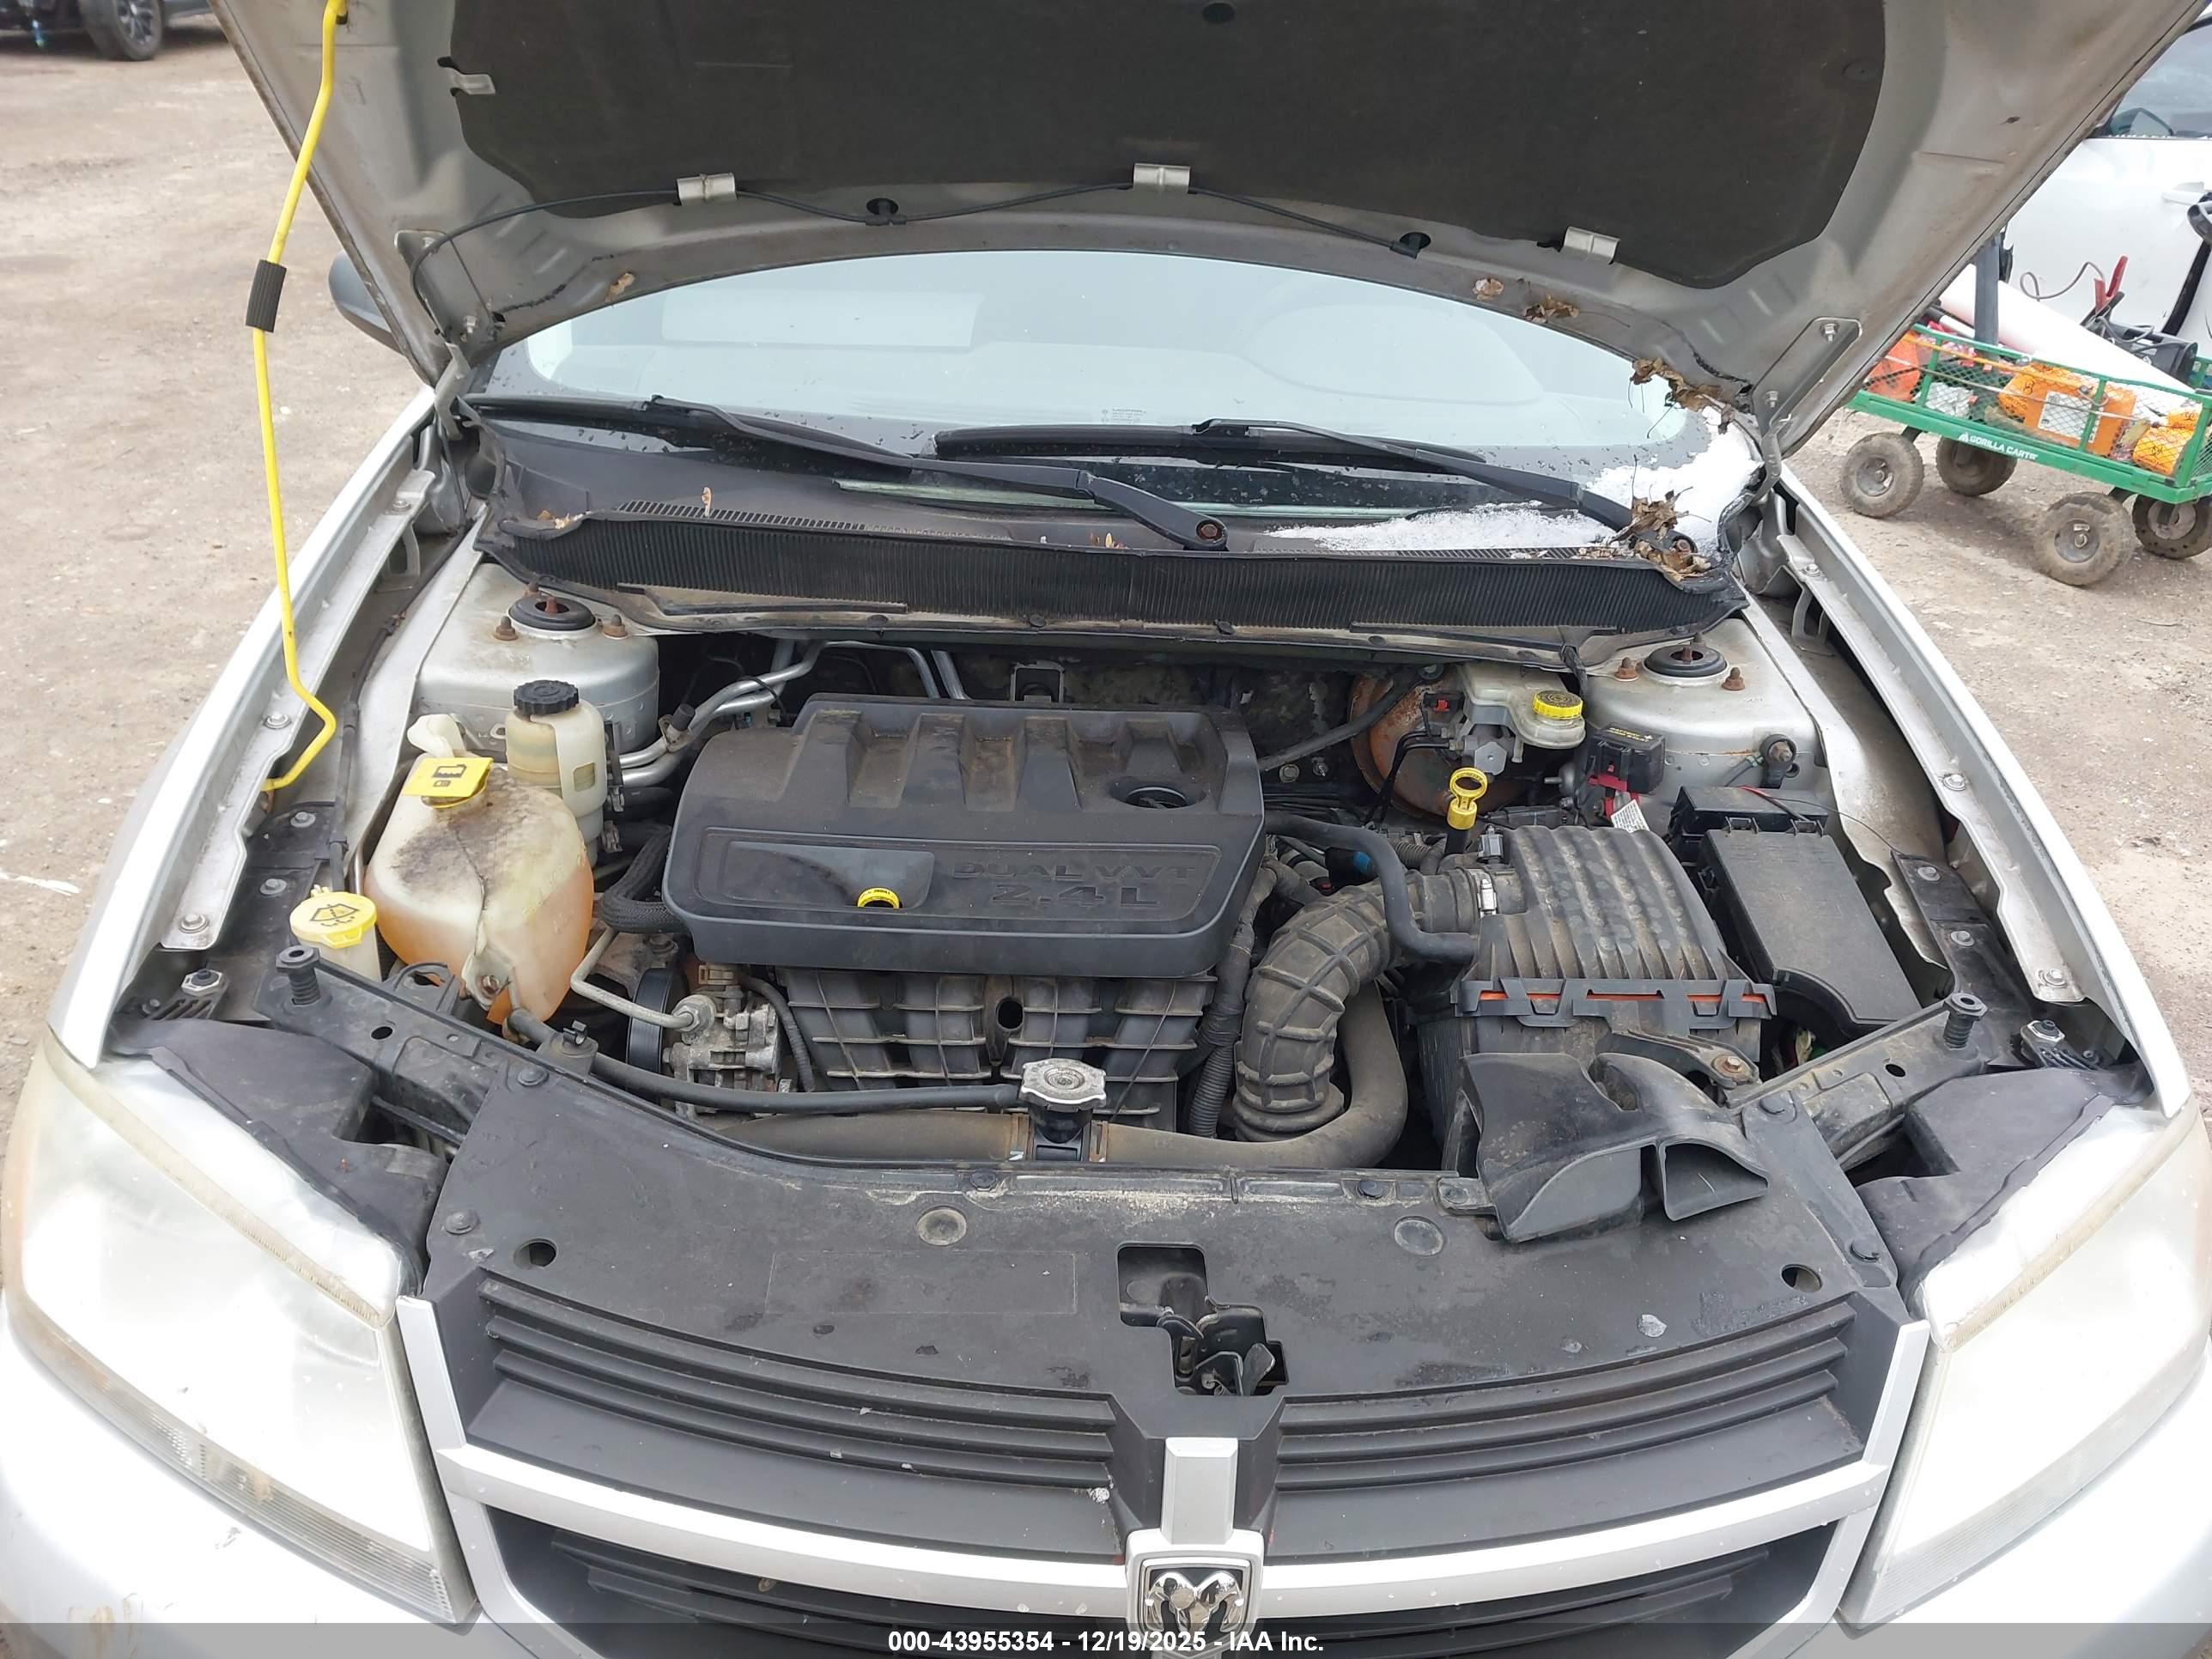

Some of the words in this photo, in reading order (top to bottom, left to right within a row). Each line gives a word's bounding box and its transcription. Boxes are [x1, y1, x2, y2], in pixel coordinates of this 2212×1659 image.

[1970, 435, 2005, 453] GORILLA
[953, 864, 1085, 882] DUAL
[1095, 865, 1197, 881] VVT
